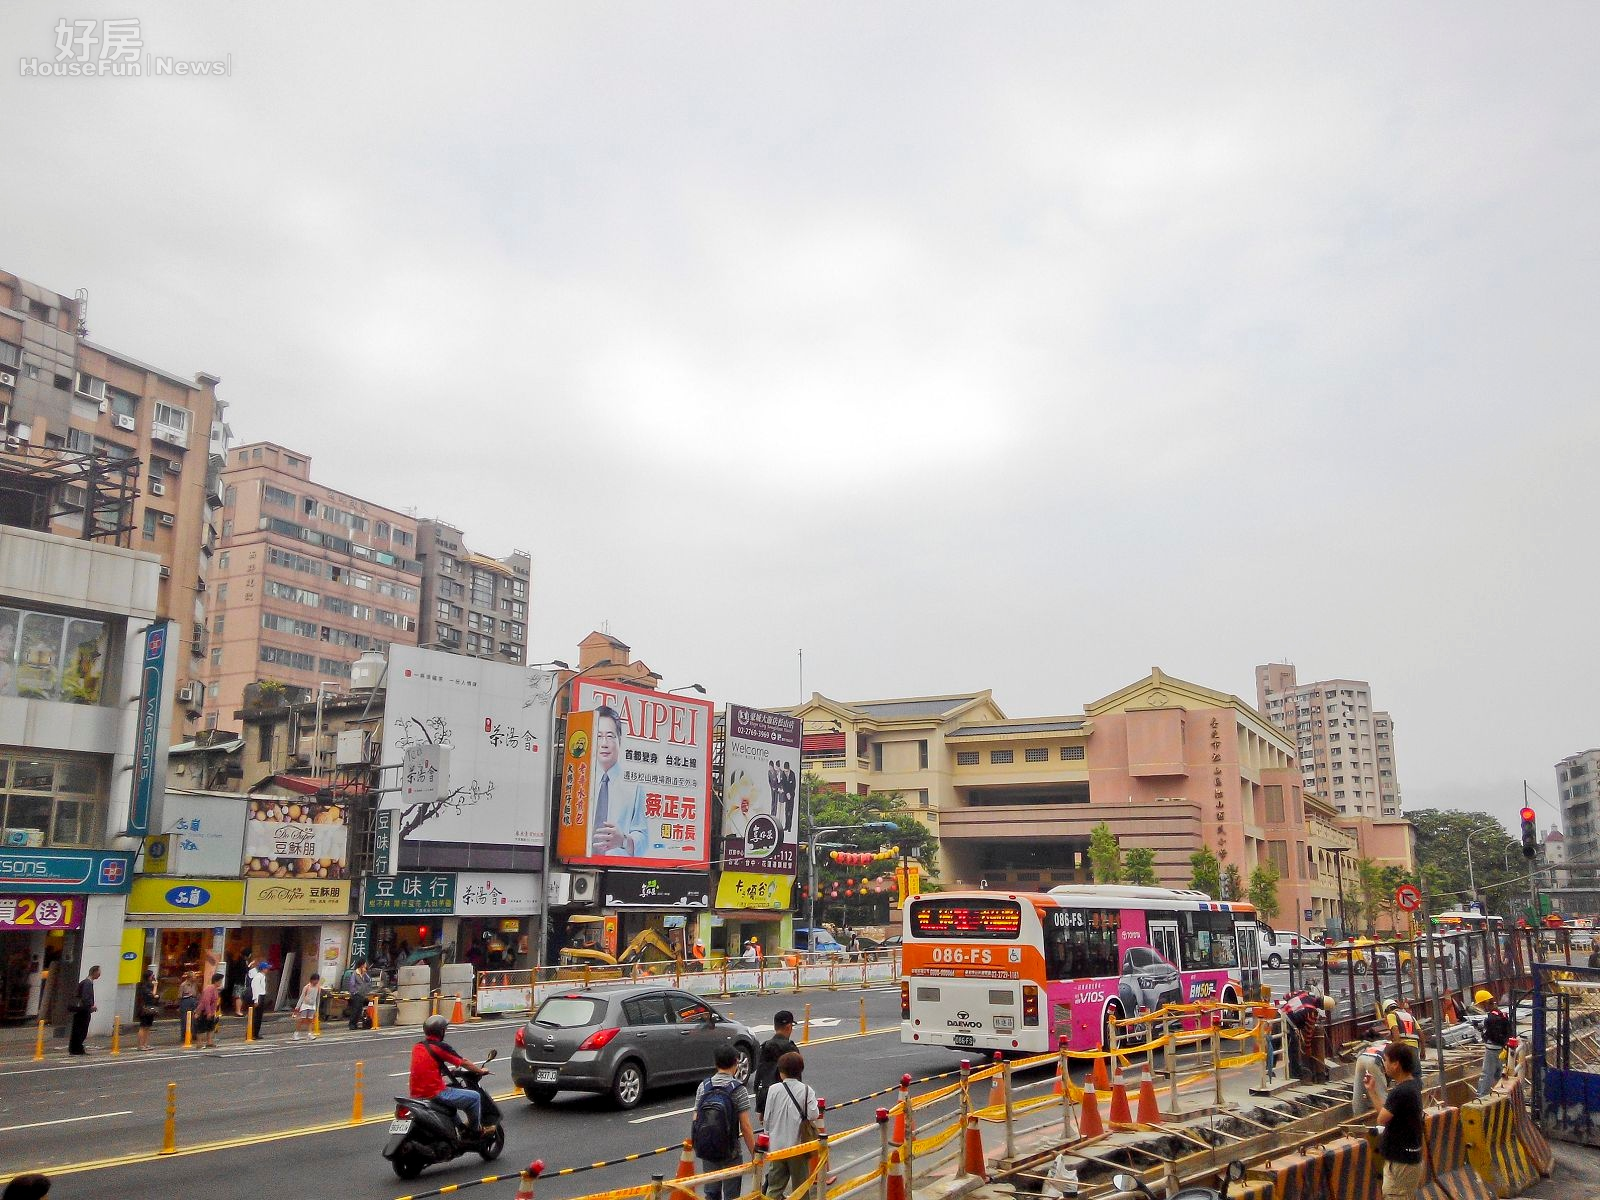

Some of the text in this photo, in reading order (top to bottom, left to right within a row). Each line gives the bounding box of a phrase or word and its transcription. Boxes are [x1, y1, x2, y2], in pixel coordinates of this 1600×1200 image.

[593, 690, 699, 747] TAIPEI
[489, 724, 538, 751] 茶湯會
[625, 749, 658, 764] 首都變身
[731, 741, 769, 758] Welcome
[645, 792, 697, 820] 蔡正元
[375, 812, 390, 874] 豆味行
[0, 861, 47, 874] sons
[375, 876, 449, 898] 豆味行
[462, 885, 502, 905] 茶湯會
[1054, 912, 1084, 927] 086-FS
[932, 947, 993, 964] 086-FS
[1080, 991, 1105, 1004] VIOS
[947, 1020, 982, 1028] DAEWOO
